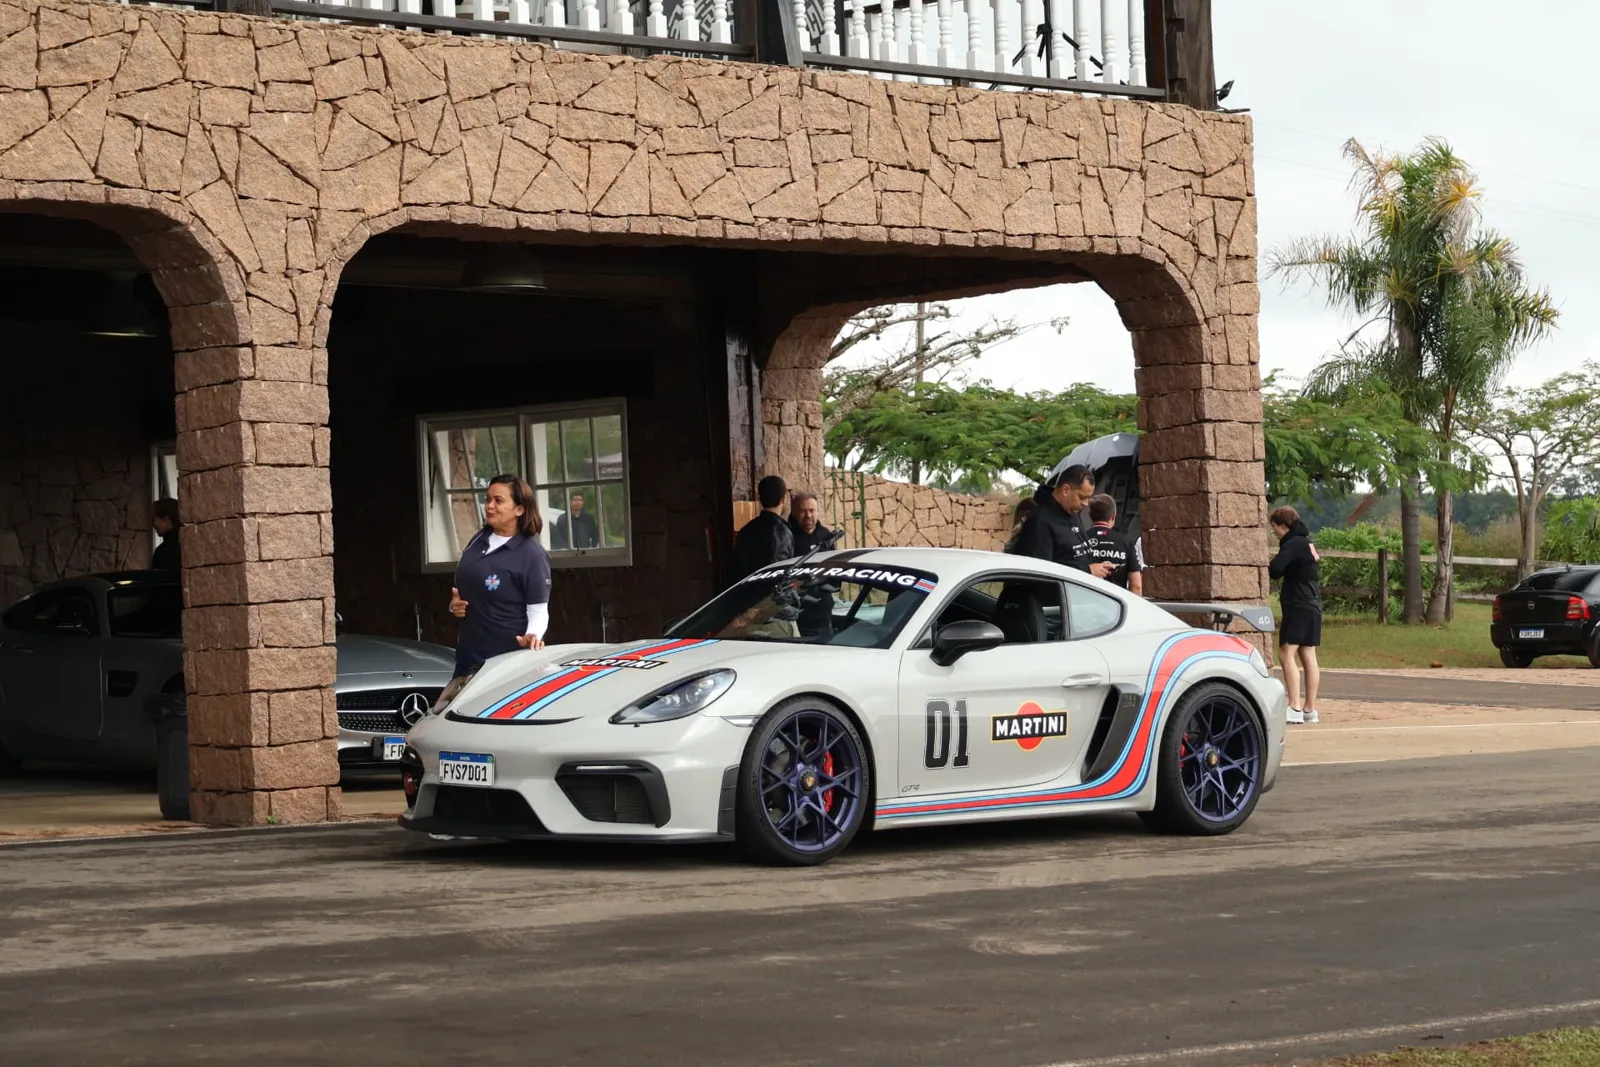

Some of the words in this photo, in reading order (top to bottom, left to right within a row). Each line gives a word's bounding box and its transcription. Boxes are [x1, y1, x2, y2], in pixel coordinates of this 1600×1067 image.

[1092, 549, 1126, 560] RONAS
[823, 567, 917, 586] RACING
[565, 659, 660, 669] MARTINI
[924, 698, 970, 770] 01
[995, 715, 1065, 737] MARTINI
[443, 762, 487, 782] FYS7D01
[901, 784, 920, 793] GT4
